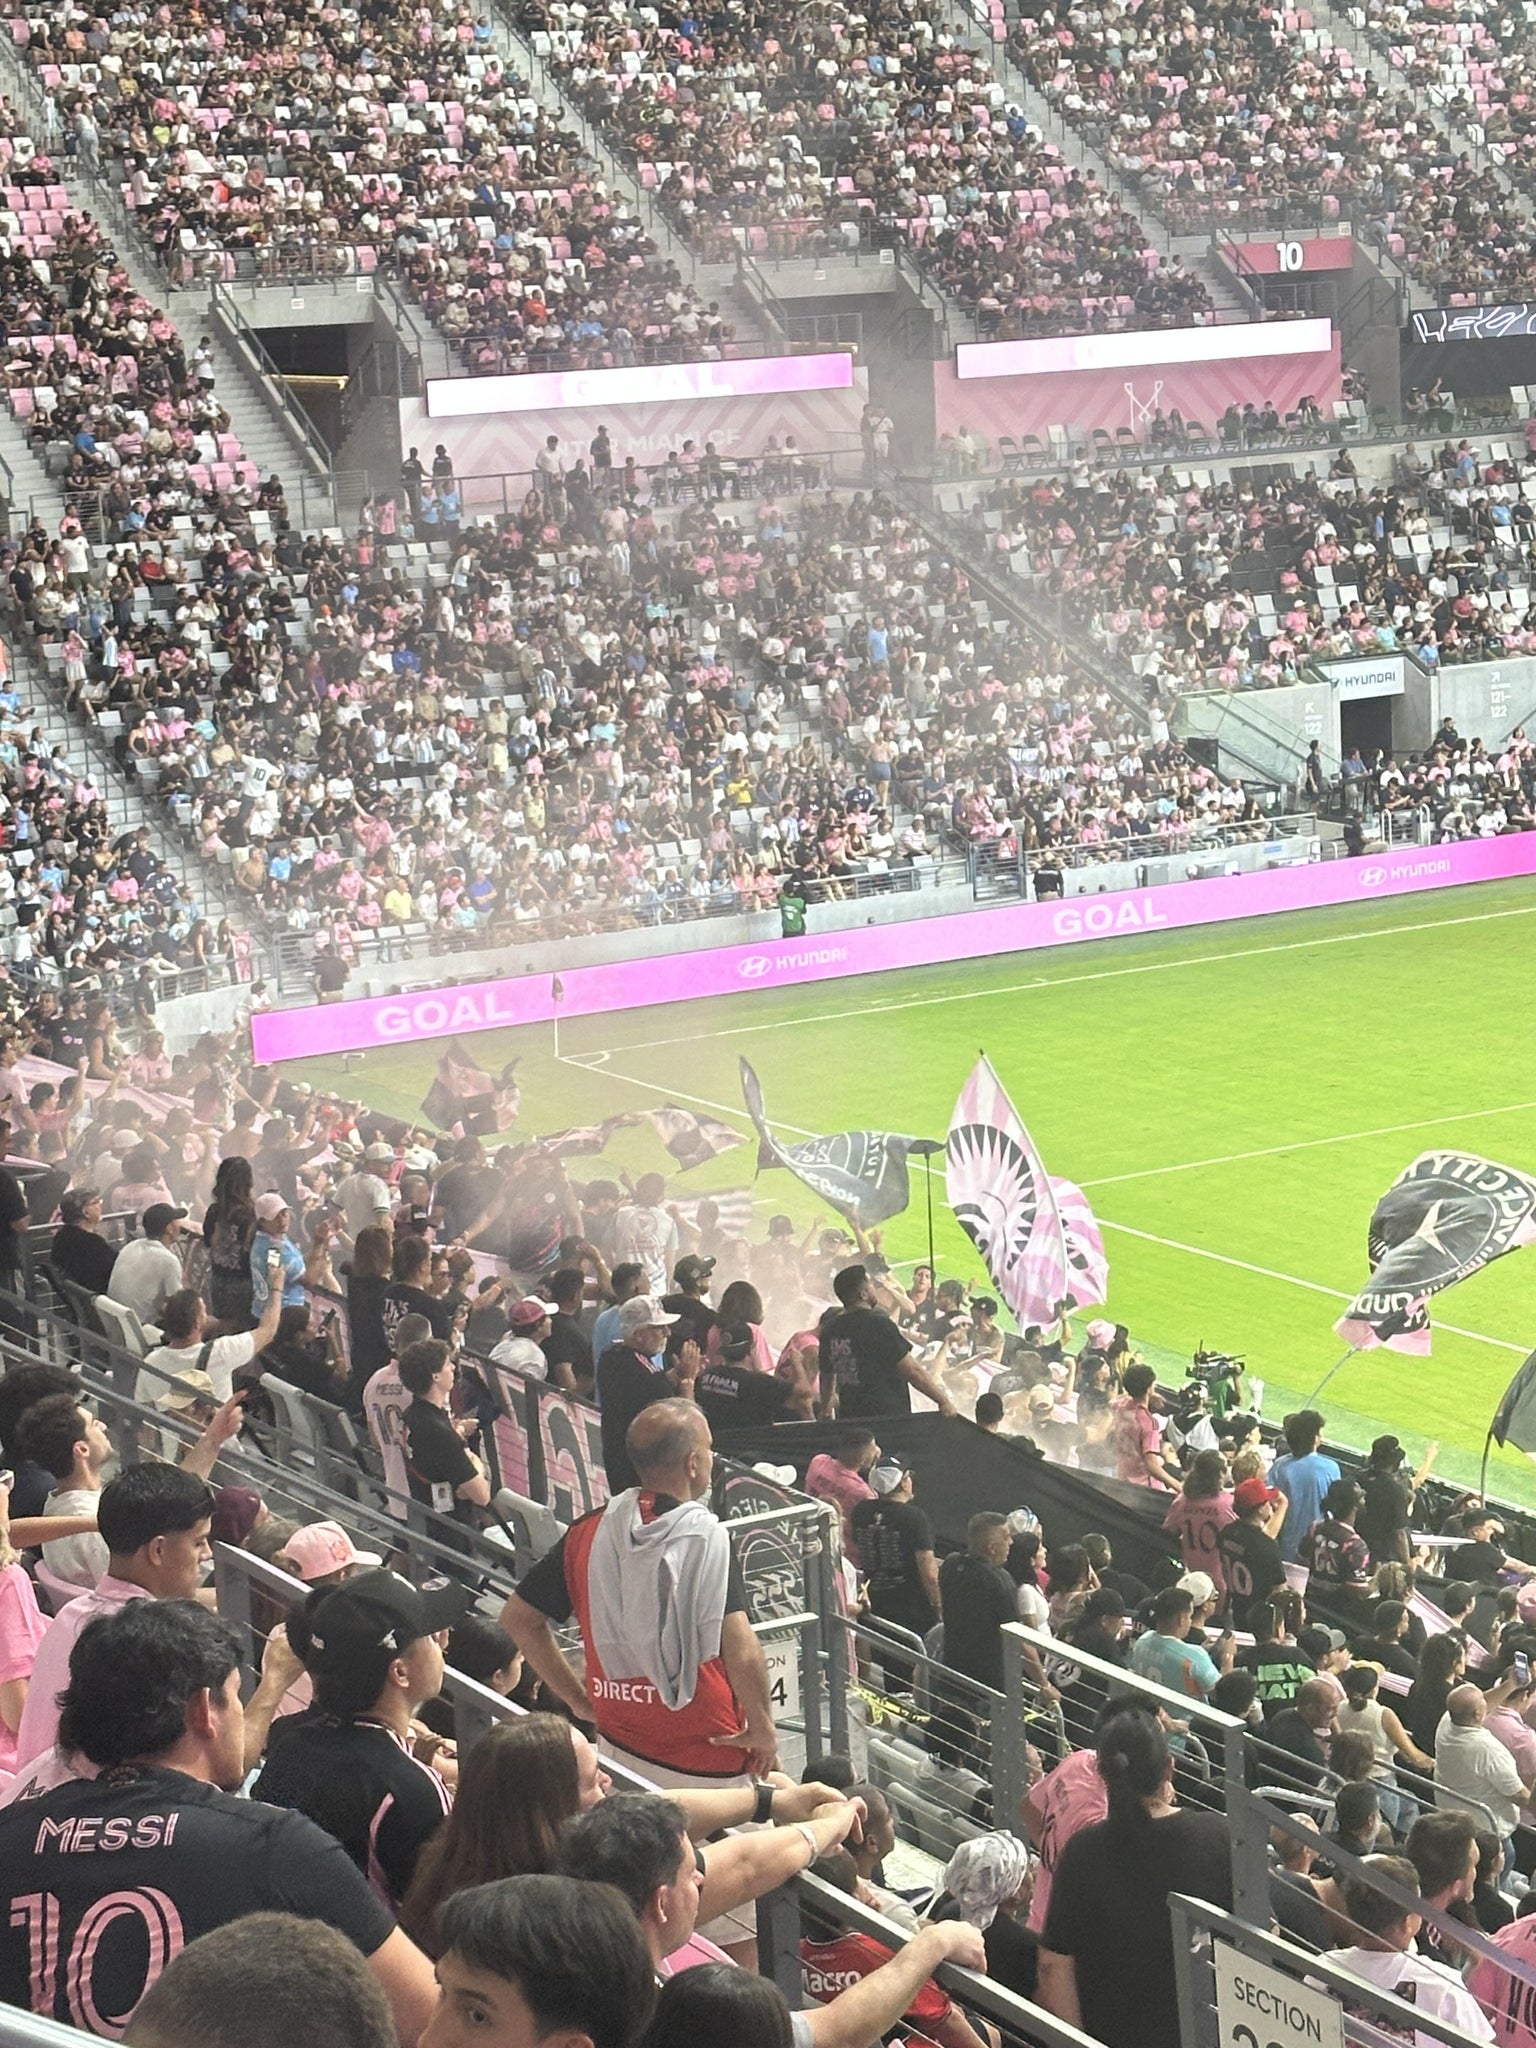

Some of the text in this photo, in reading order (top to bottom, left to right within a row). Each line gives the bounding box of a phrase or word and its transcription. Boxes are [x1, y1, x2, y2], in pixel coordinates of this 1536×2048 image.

[1276, 241, 1304, 272] 10
[559, 363, 734, 400] GAL
[1345, 671, 1396, 685] HYUNDAI
[1490, 705, 1507, 718] 122
[253, 767, 266, 781] 10
[1391, 859, 1450, 880] HYUNDAI
[1052, 897, 1167, 937] GOAL
[776, 947, 847, 971] HYUNDAI
[374, 991, 512, 1037] GOAL
[1185, 1519, 1220, 1553] 10
[34, 1812, 179, 1854] MESSI
[10, 1885, 185, 2042] 10
[1234, 1976, 1323, 2043] SECTION
